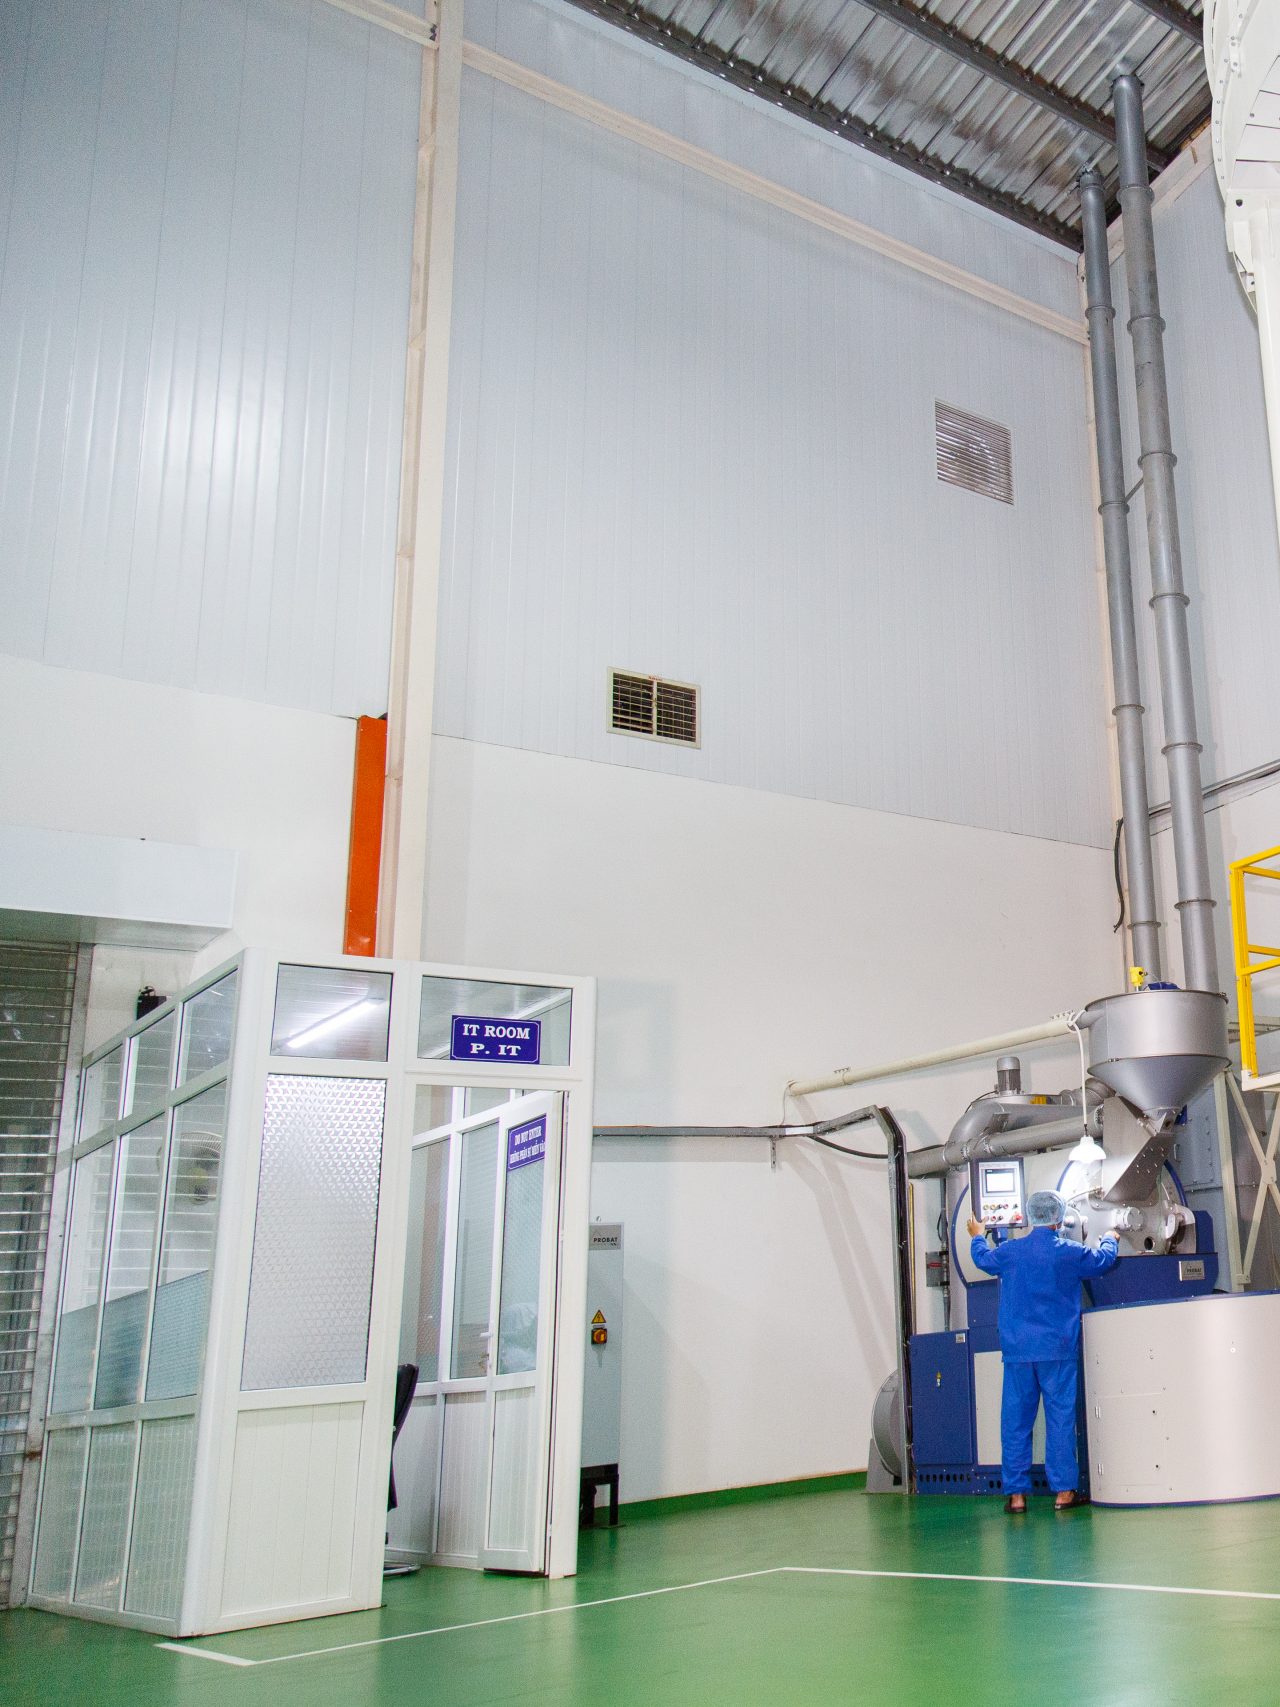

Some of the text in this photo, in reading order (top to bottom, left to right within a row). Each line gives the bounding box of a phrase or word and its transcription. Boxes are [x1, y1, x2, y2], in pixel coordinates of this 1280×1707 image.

[462, 1023, 531, 1039] IT ROOM
[470, 1042, 521, 1056] P. IT
